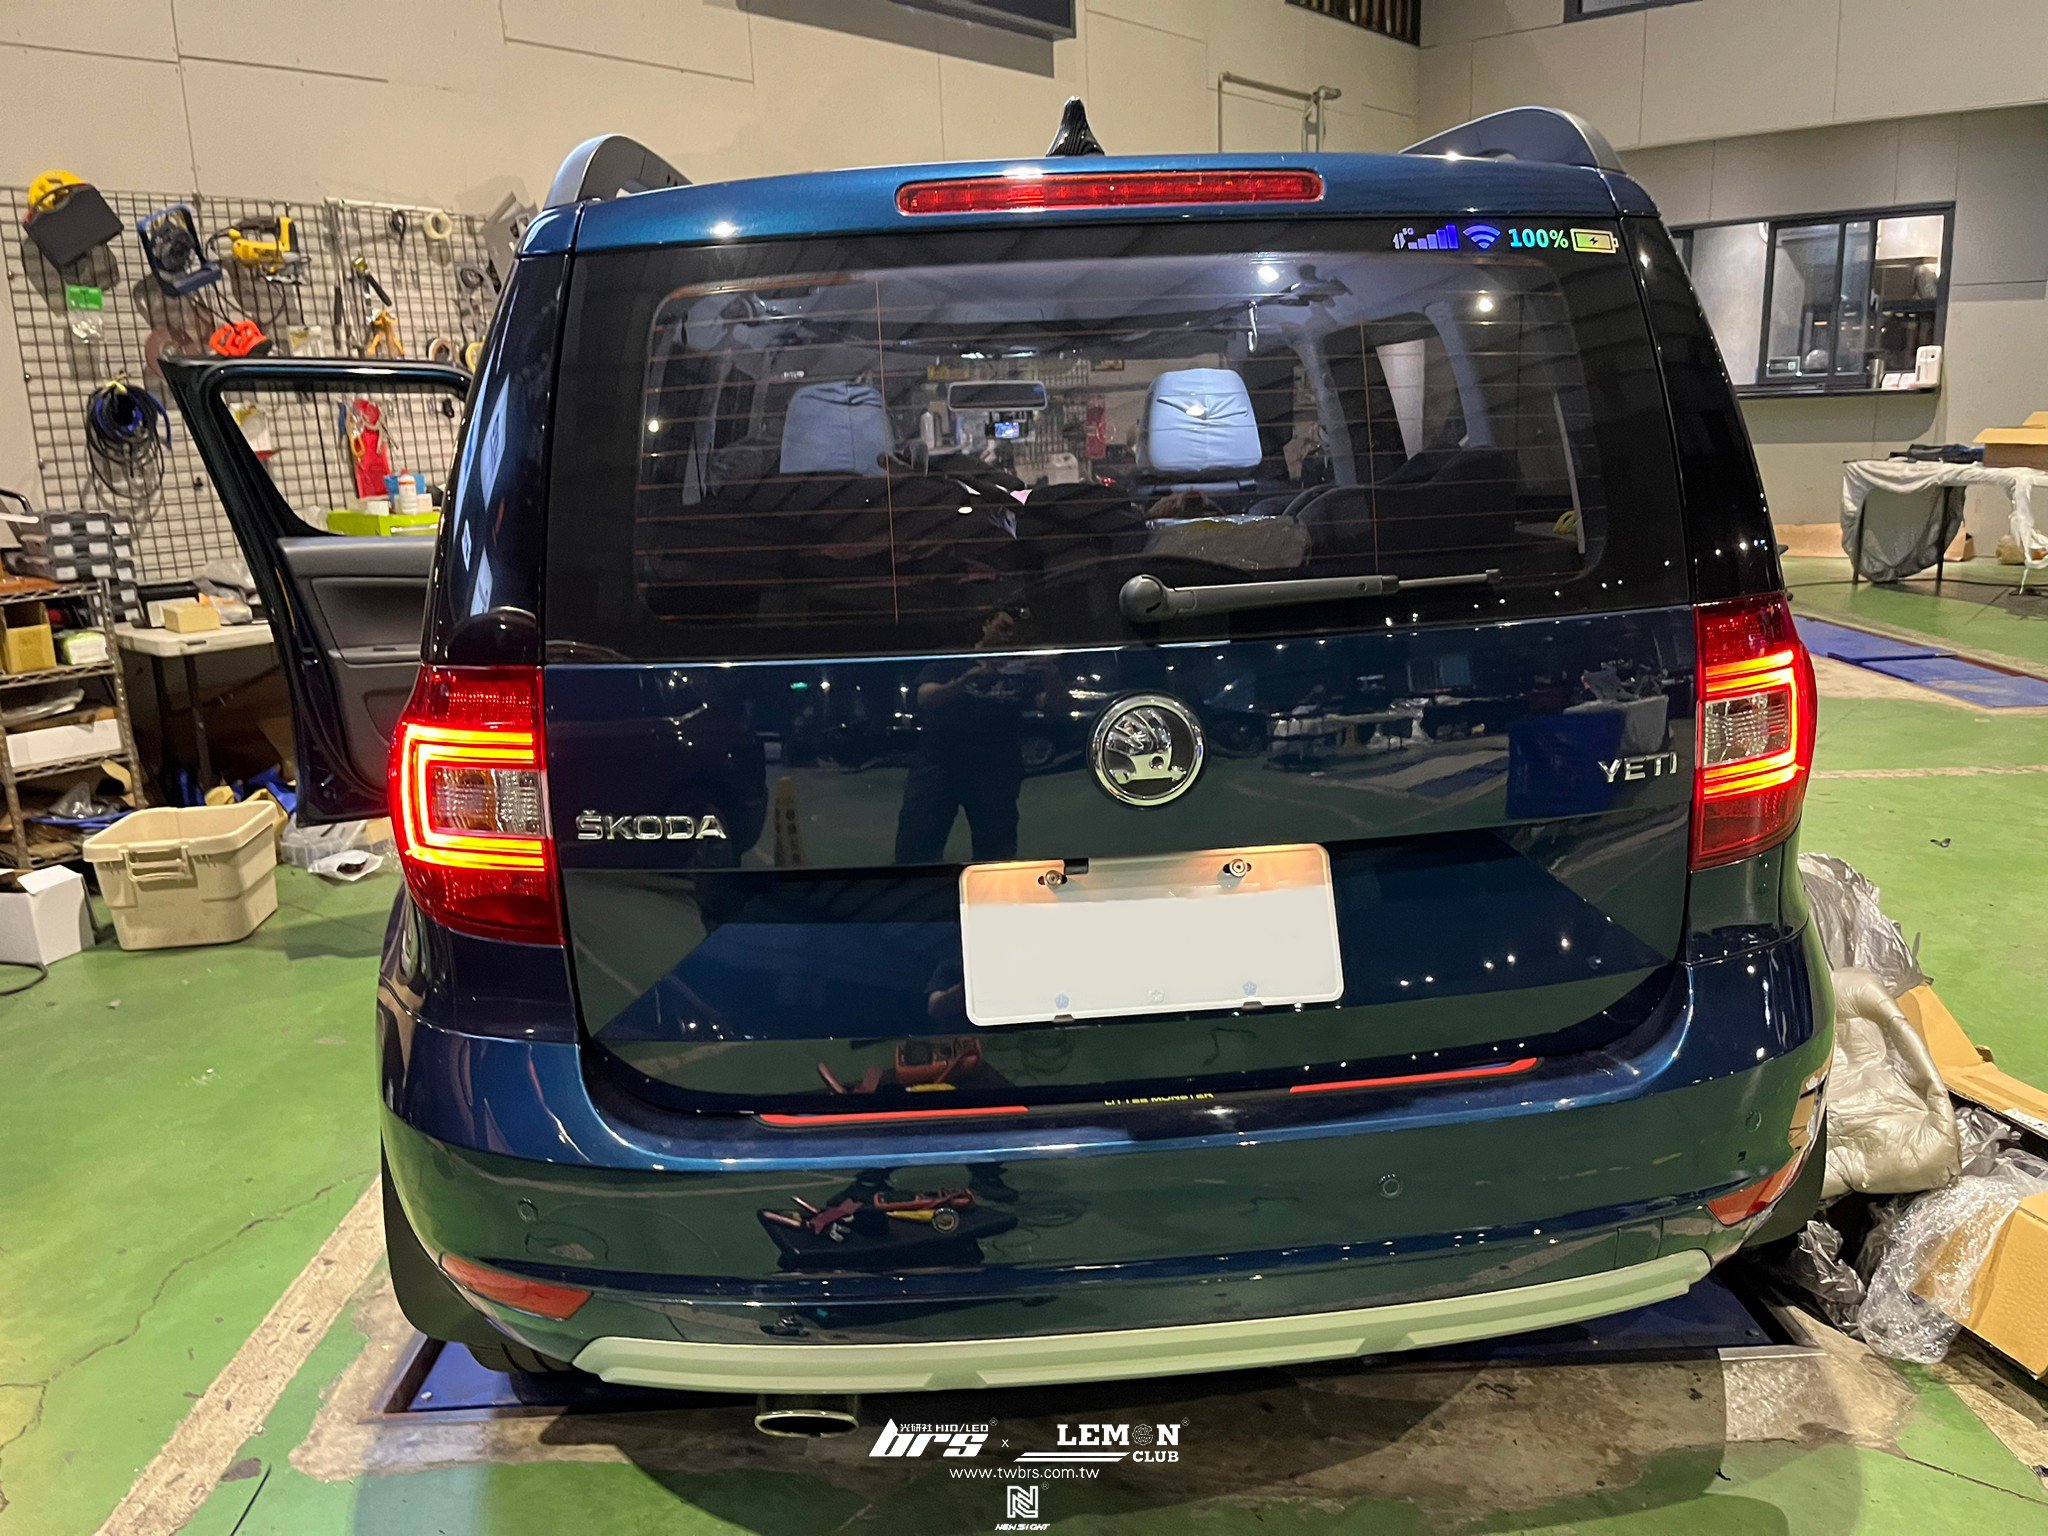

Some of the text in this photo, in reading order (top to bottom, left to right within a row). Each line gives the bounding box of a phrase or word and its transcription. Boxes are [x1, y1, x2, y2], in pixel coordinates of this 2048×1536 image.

[1508, 228, 1569, 248] 100%
[1598, 751, 1677, 783] YETI
[575, 809, 727, 840] ŠKODA
